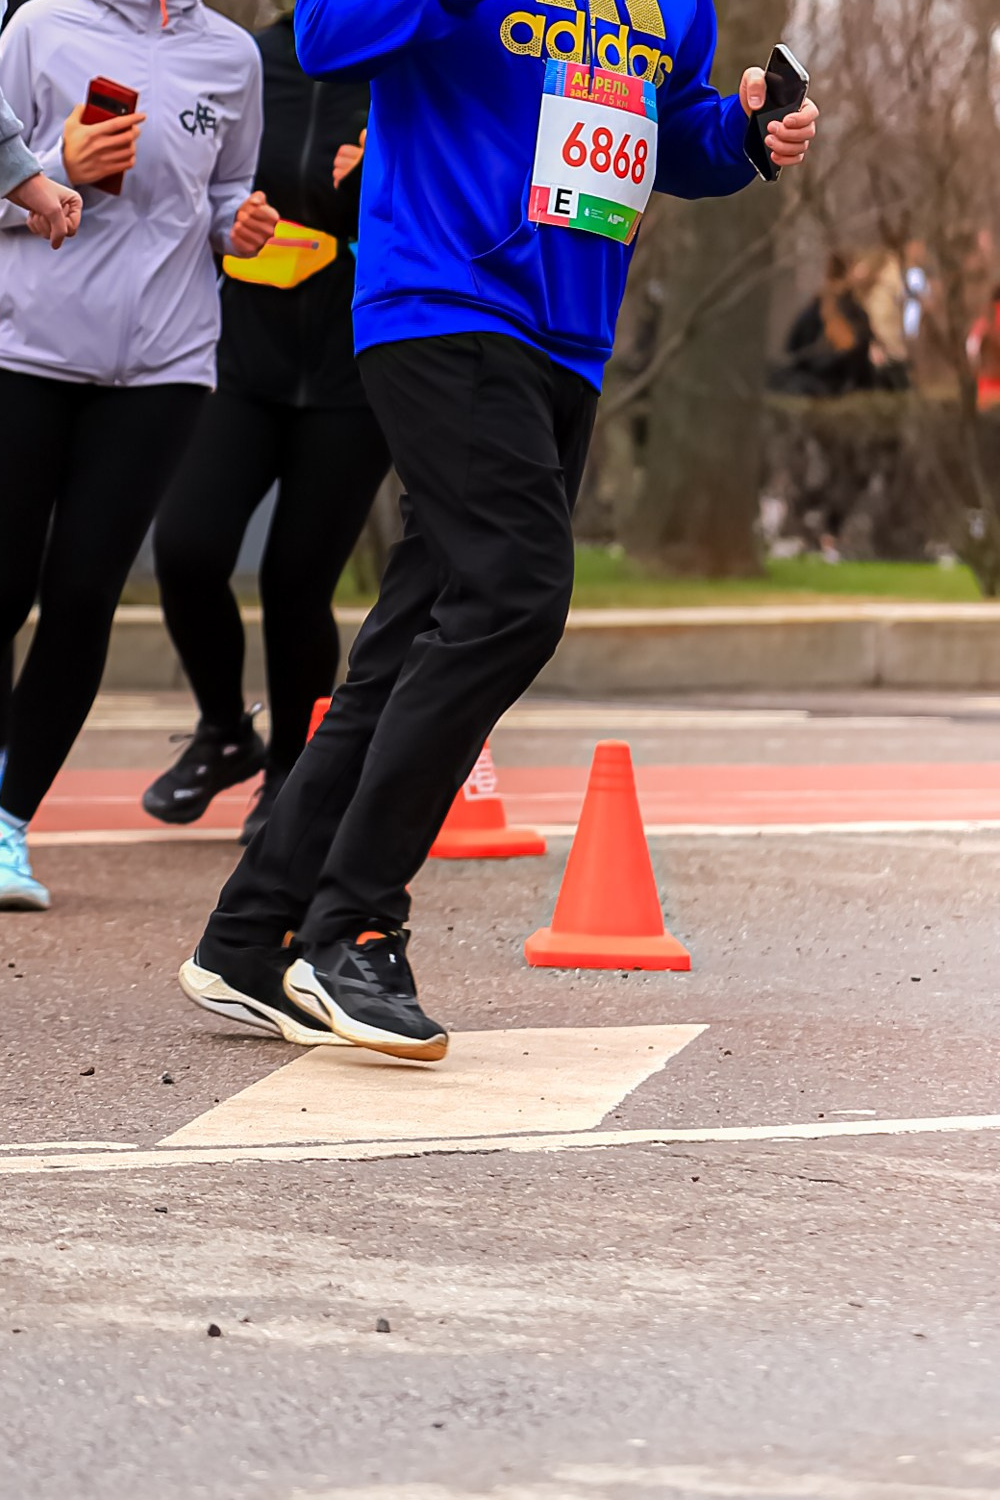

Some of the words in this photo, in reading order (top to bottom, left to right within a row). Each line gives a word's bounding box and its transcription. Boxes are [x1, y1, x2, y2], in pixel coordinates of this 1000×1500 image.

[500, 10, 673, 90] adidas
[608, 95, 615, 105] 5
[561, 121, 649, 186] 6868
[554, 187, 573, 216] E
